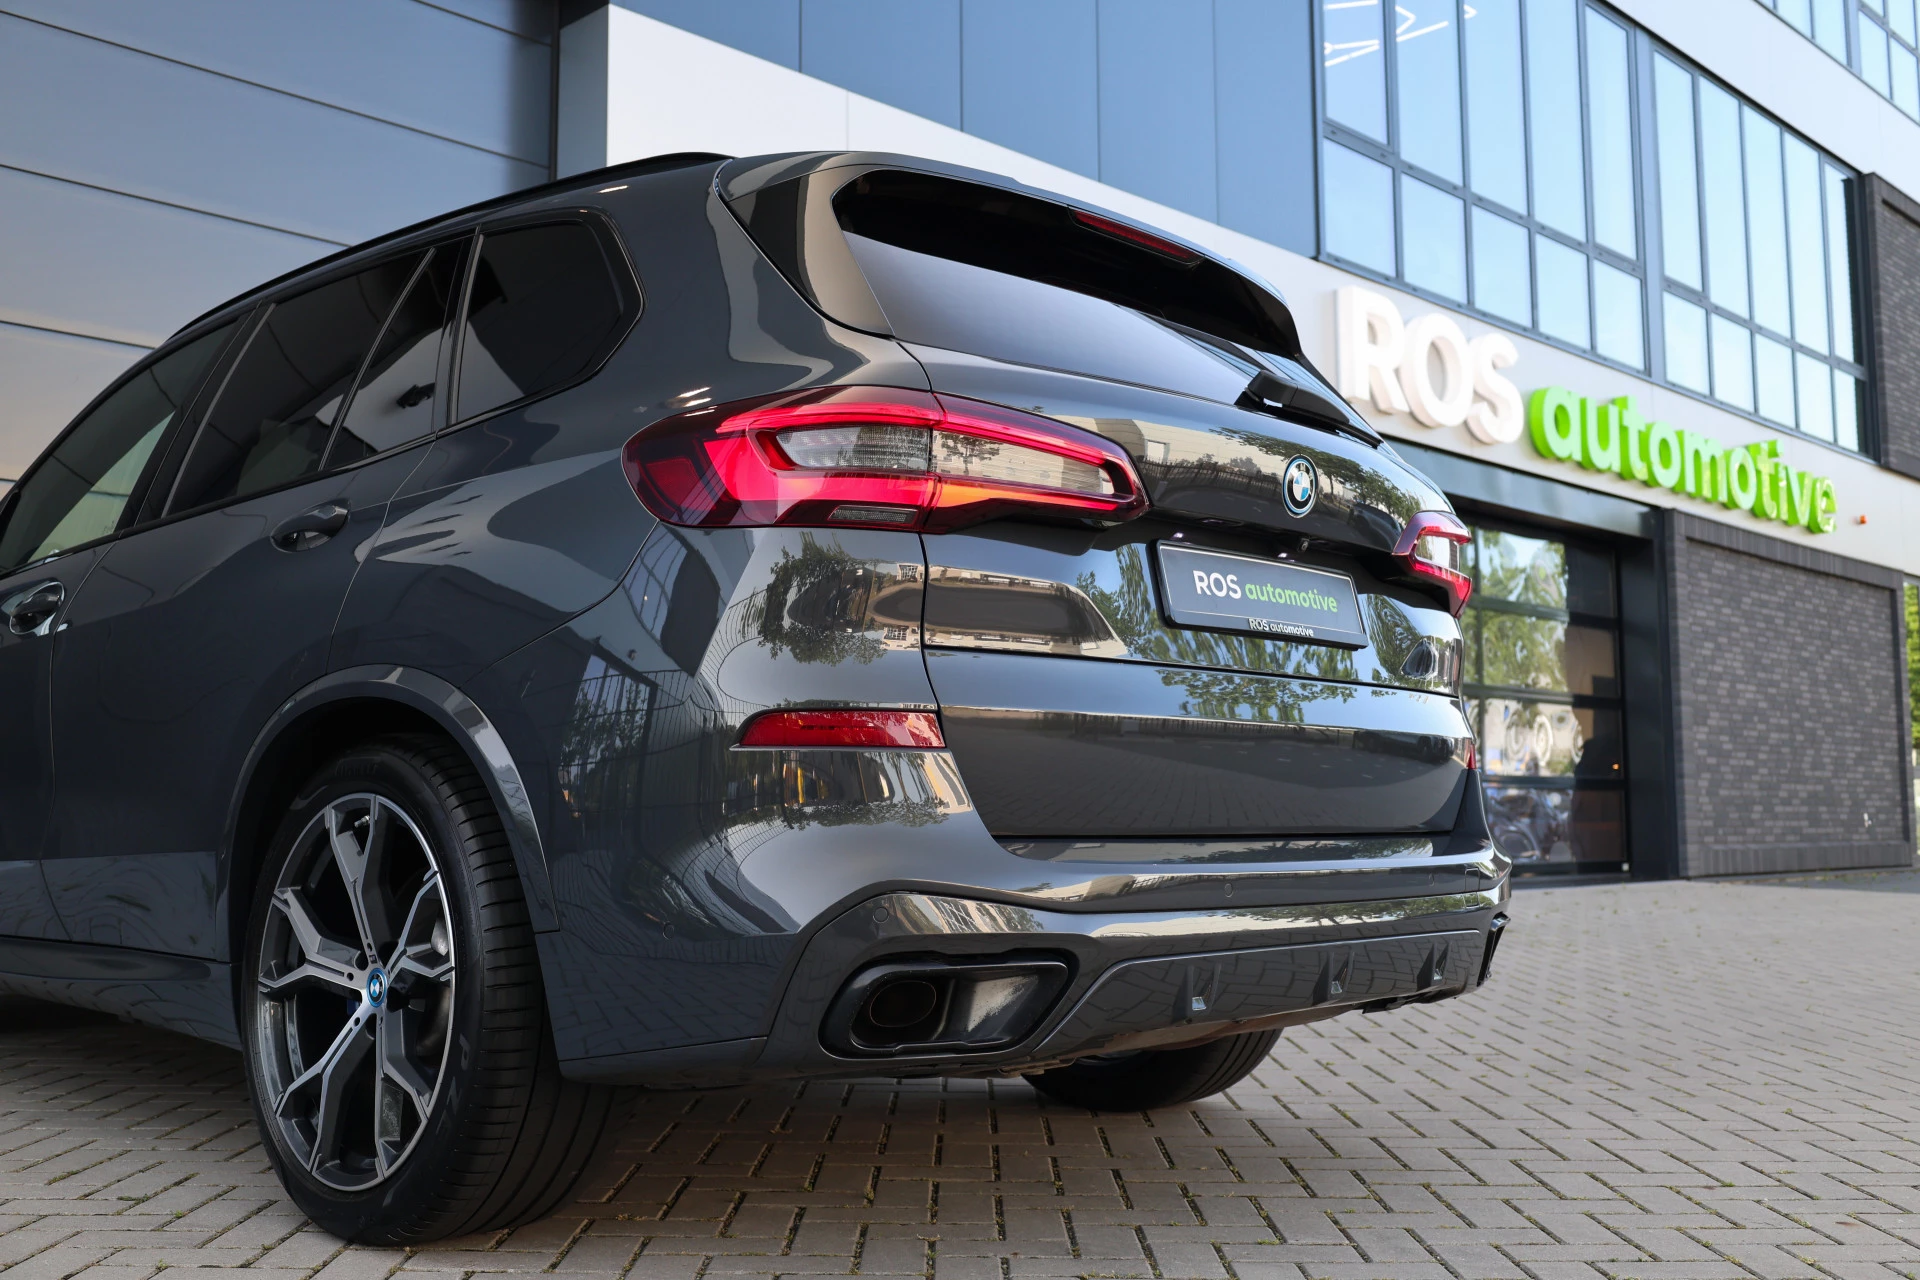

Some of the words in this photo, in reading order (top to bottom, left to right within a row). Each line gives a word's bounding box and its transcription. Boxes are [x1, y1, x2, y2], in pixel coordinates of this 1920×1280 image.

[1336, 285, 1525, 445] ROS
[1530, 387, 1838, 534] automotive
[1193, 570, 1241, 600] ROS
[1245, 583, 1338, 613] automotive
[1249, 618, 1269, 632] ROS
[1270, 623, 1314, 637] automotive
